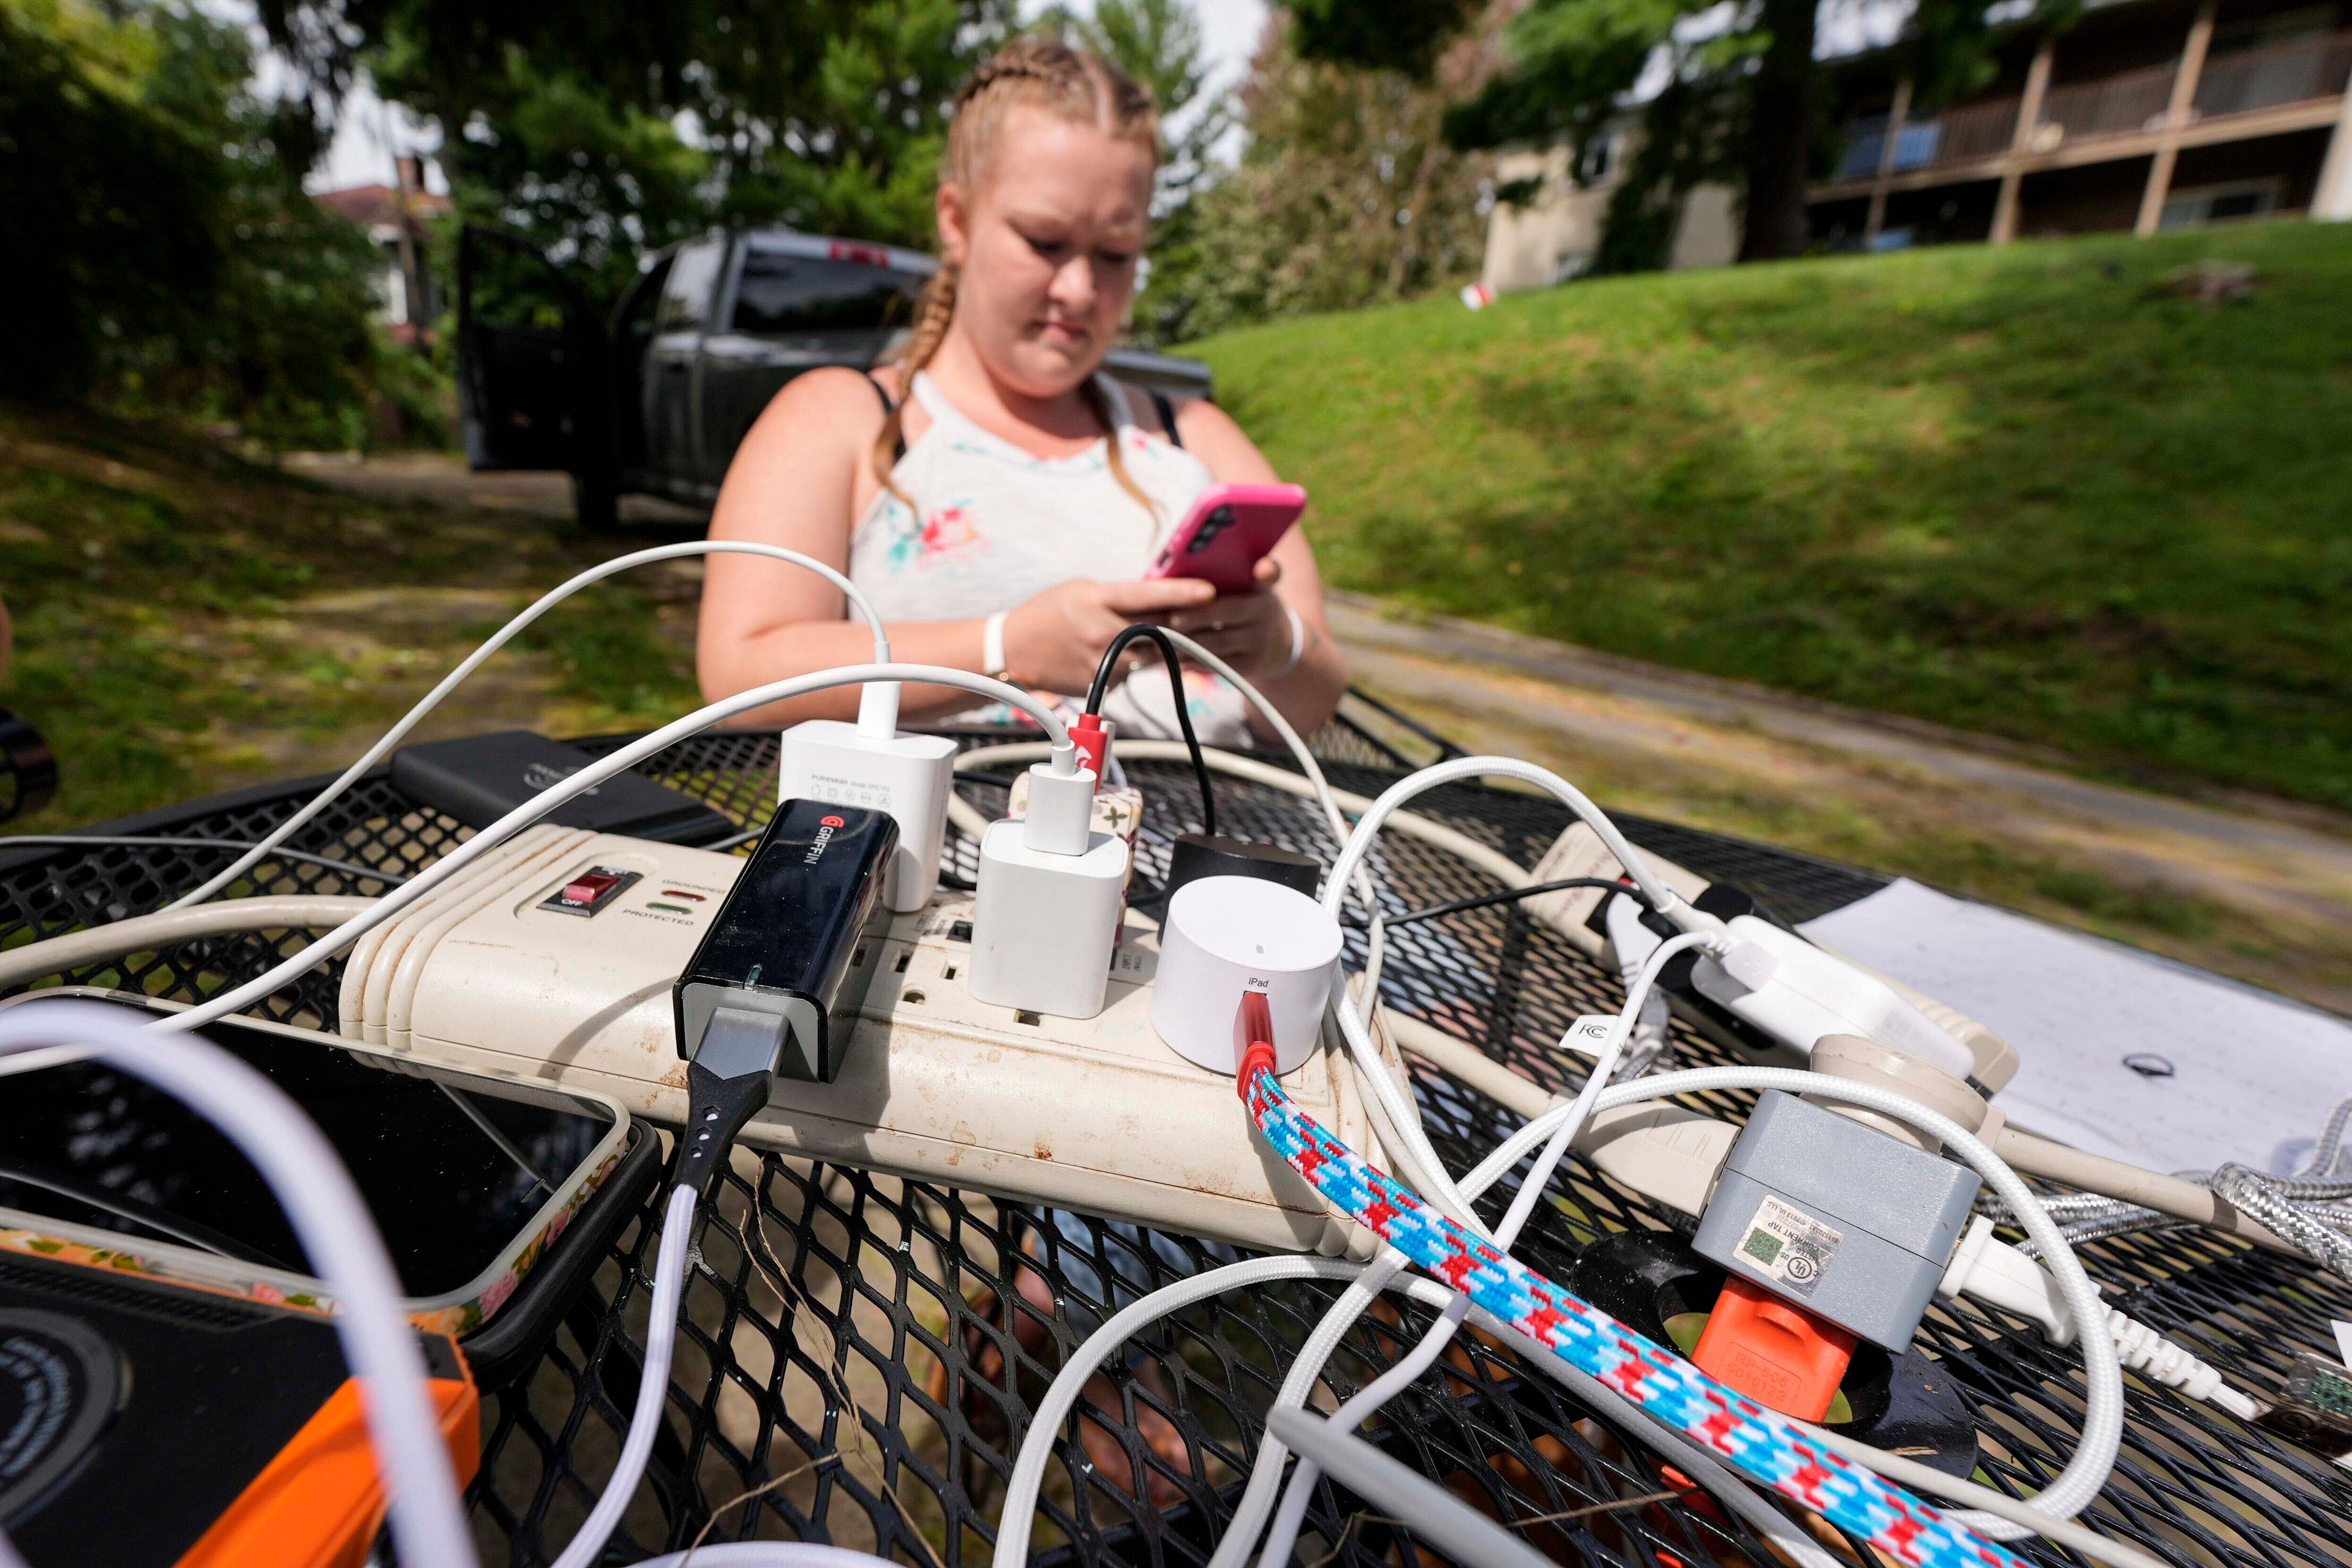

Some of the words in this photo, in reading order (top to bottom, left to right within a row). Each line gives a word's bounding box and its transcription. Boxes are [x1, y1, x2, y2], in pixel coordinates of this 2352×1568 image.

[804, 826, 834, 864] GRIFFIN
[662, 880, 726, 894] GROUNDED
[622, 909, 694, 926] PROTECTED
[1248, 977, 1268, 987] iPad
[1766, 1202, 1777, 1211] LLC
[1768, 1221, 1782, 1232] TAP
[1782, 1229, 1819, 1253] CURRENT
[1780, 1251, 1789, 1261] US
[1796, 1248, 1819, 1262] LISTED
